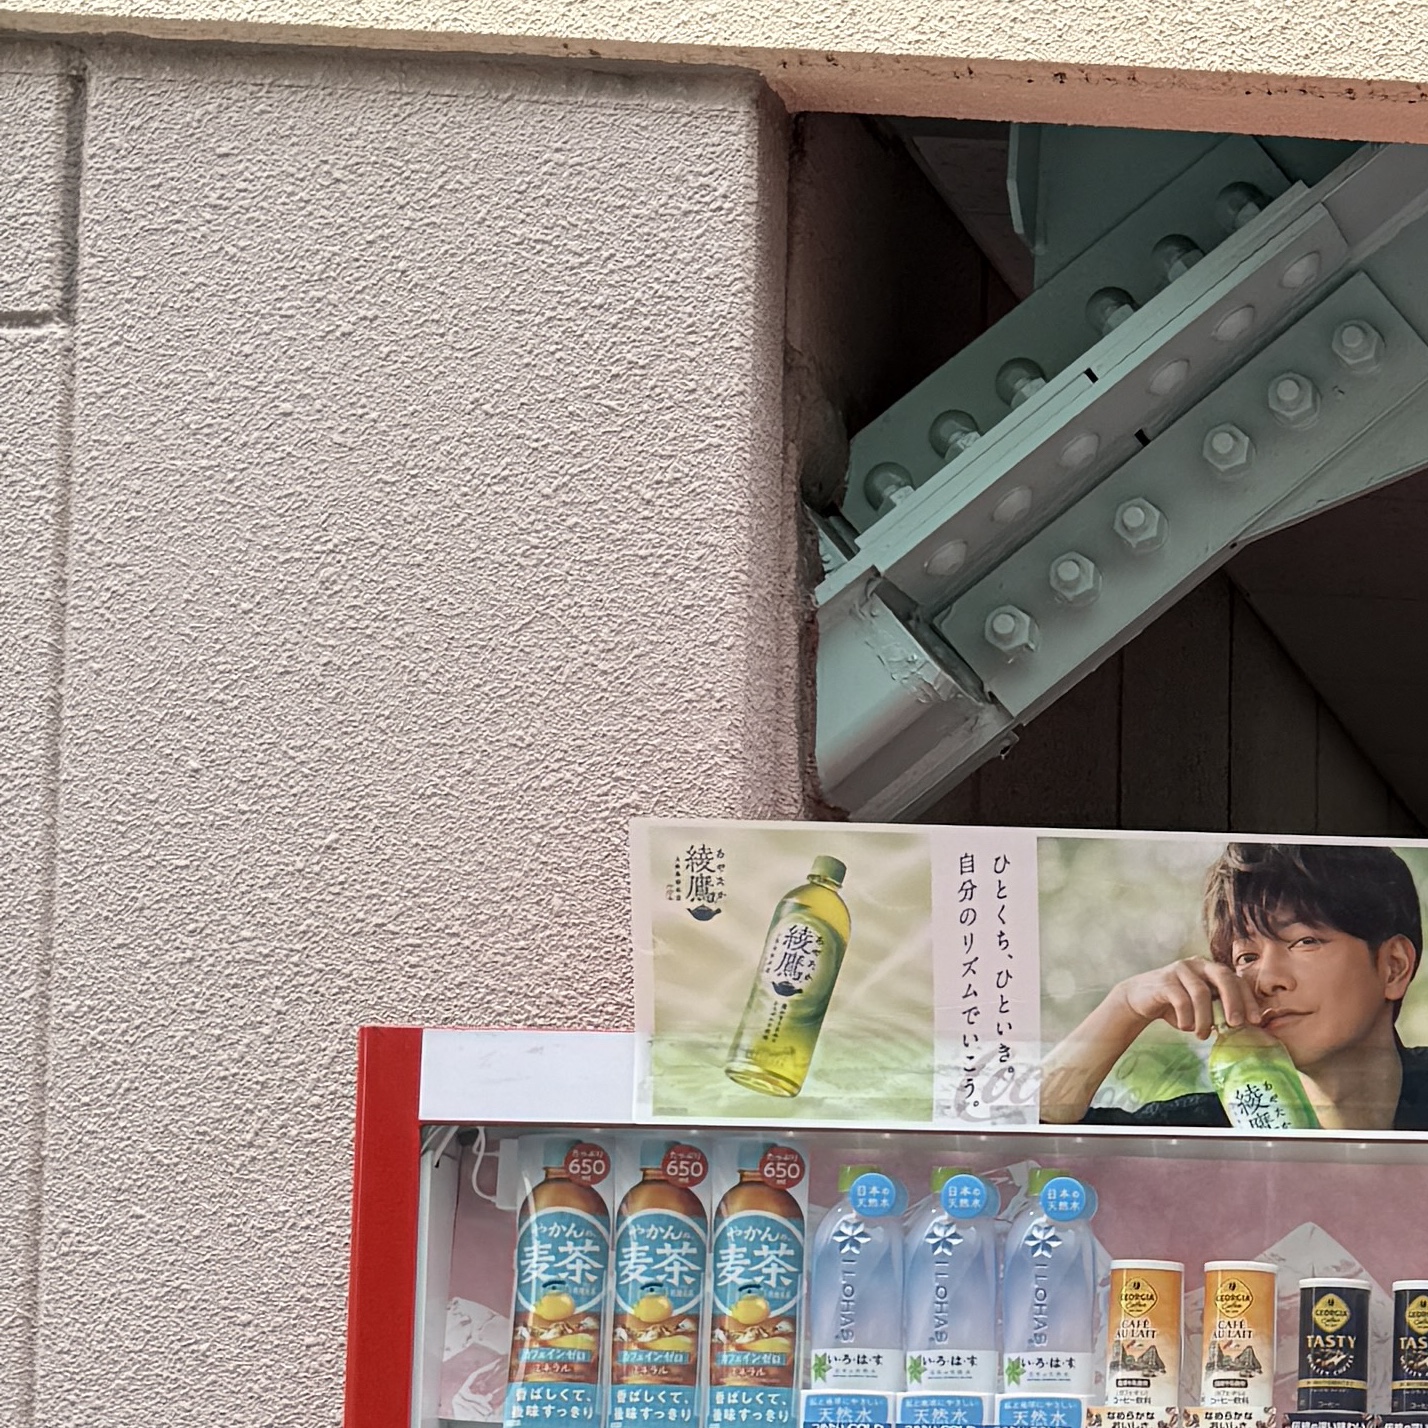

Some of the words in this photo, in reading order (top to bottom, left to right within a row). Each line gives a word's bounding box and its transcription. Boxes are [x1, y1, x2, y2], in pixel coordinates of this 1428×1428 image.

[992, 853, 1016, 1076] ひとくち、ひといき。
[958, 853, 982, 1108] 自分のリズムでいこう。
[567, 1160, 605, 1175] 650
[666, 1161, 704, 1176] 650
[763, 1162, 800, 1178] 650
[520, 1242, 604, 1285] 麦茶
[619, 1243, 702, 1286] 麦茶
[715, 1244, 799, 1288] 麦茶
[1307, 1336, 1357, 1350] TASTY
[818, 1408, 874, 1425] 天然水
[914, 1409, 970, 1426] 天然水
[1106, 1411, 1155, 1422] なめらかな
